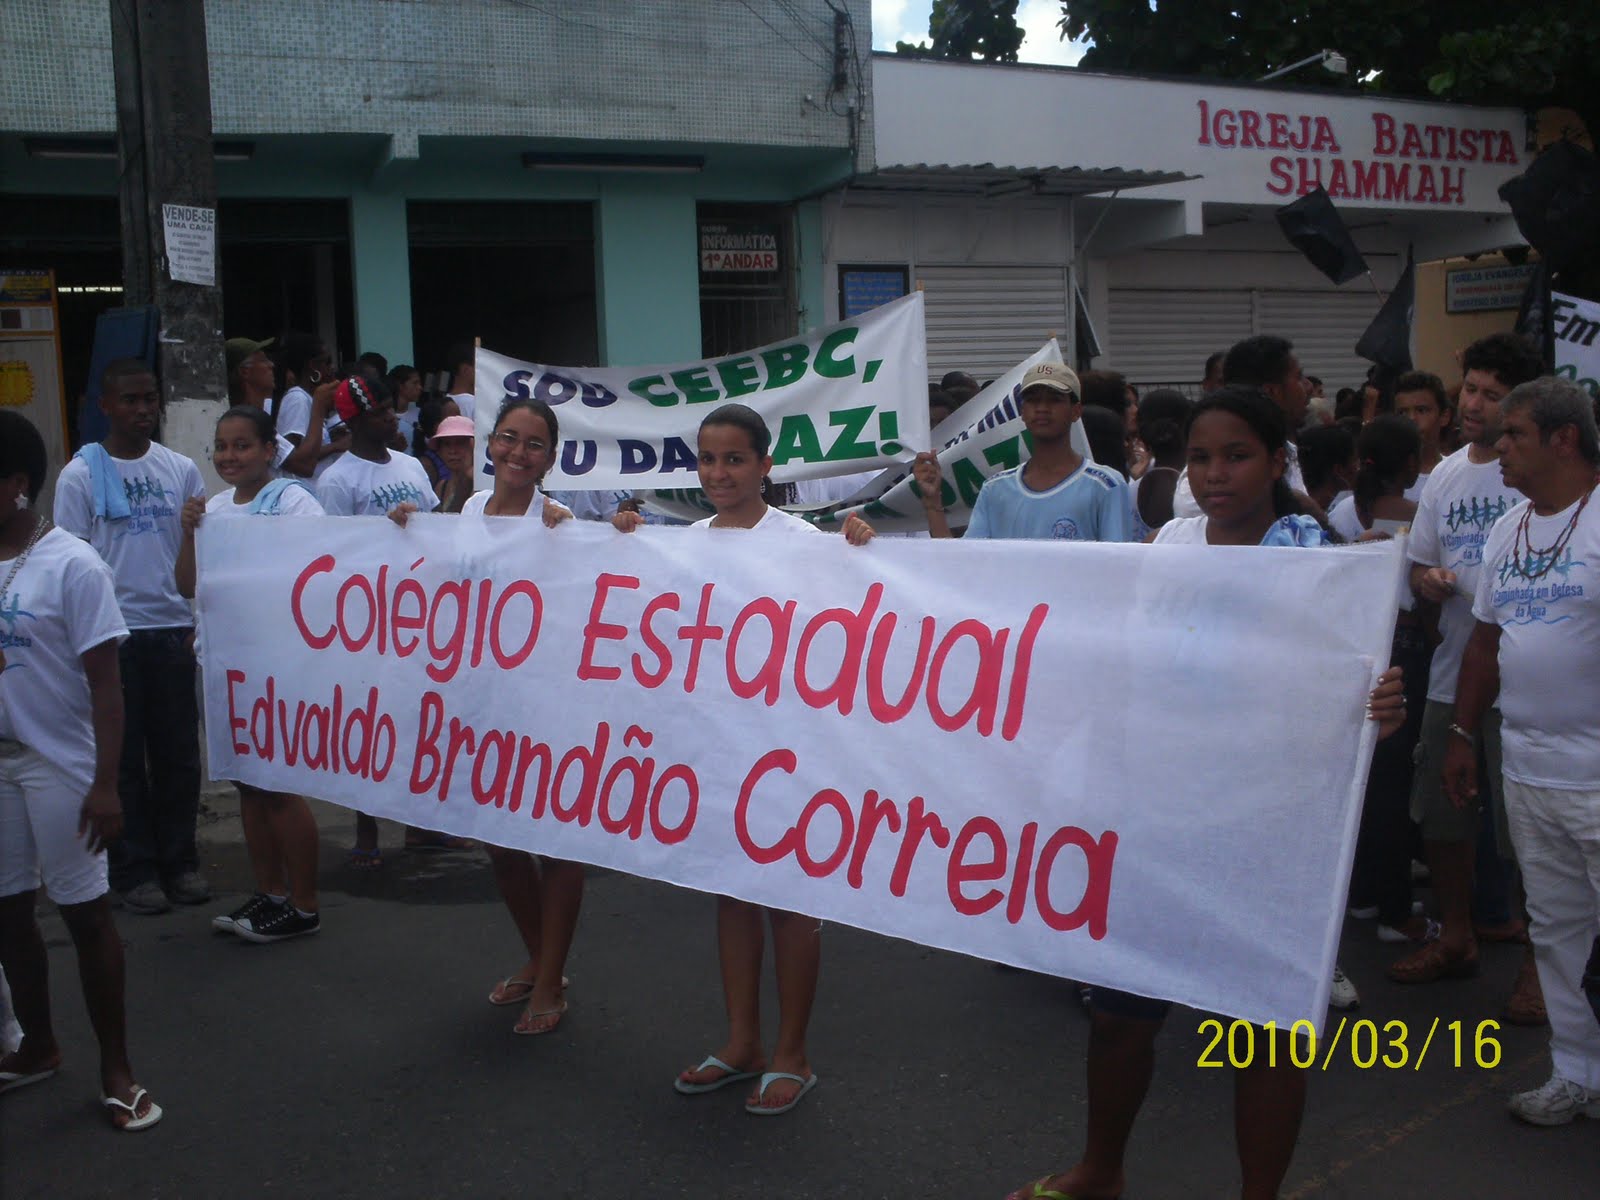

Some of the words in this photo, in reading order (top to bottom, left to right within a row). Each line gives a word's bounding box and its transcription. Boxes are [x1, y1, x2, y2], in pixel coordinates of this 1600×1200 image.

[1197, 99, 1340, 152] IGREJA
[1371, 112, 1519, 164] BATISTA
[1266, 156, 1466, 203] SHAMMAH
[164, 206, 214, 224] VENDE-SE
[167, 221, 187, 229] UMA
[189, 223, 213, 232] CASA
[722, 253, 774, 268] ANDAR
[502, 370, 618, 408] SOU
[628, 327, 884, 407] CEEBC,
[616, 437, 698, 475] DA
[765, 405, 904, 466] AZ!
[1493, 586, 1534, 602] Caminhada
[1536, 588, 1549, 598] em
[1551, 583, 1584, 598] Defesa
[1515, 605, 1525, 617] da
[291, 554, 543, 683] Colégio
[577, 572, 1049, 741] Estadual
[226, 669, 397, 783] Edvaldo
[409, 691, 699, 845] Brandão
[734, 748, 1118, 941] Correia
